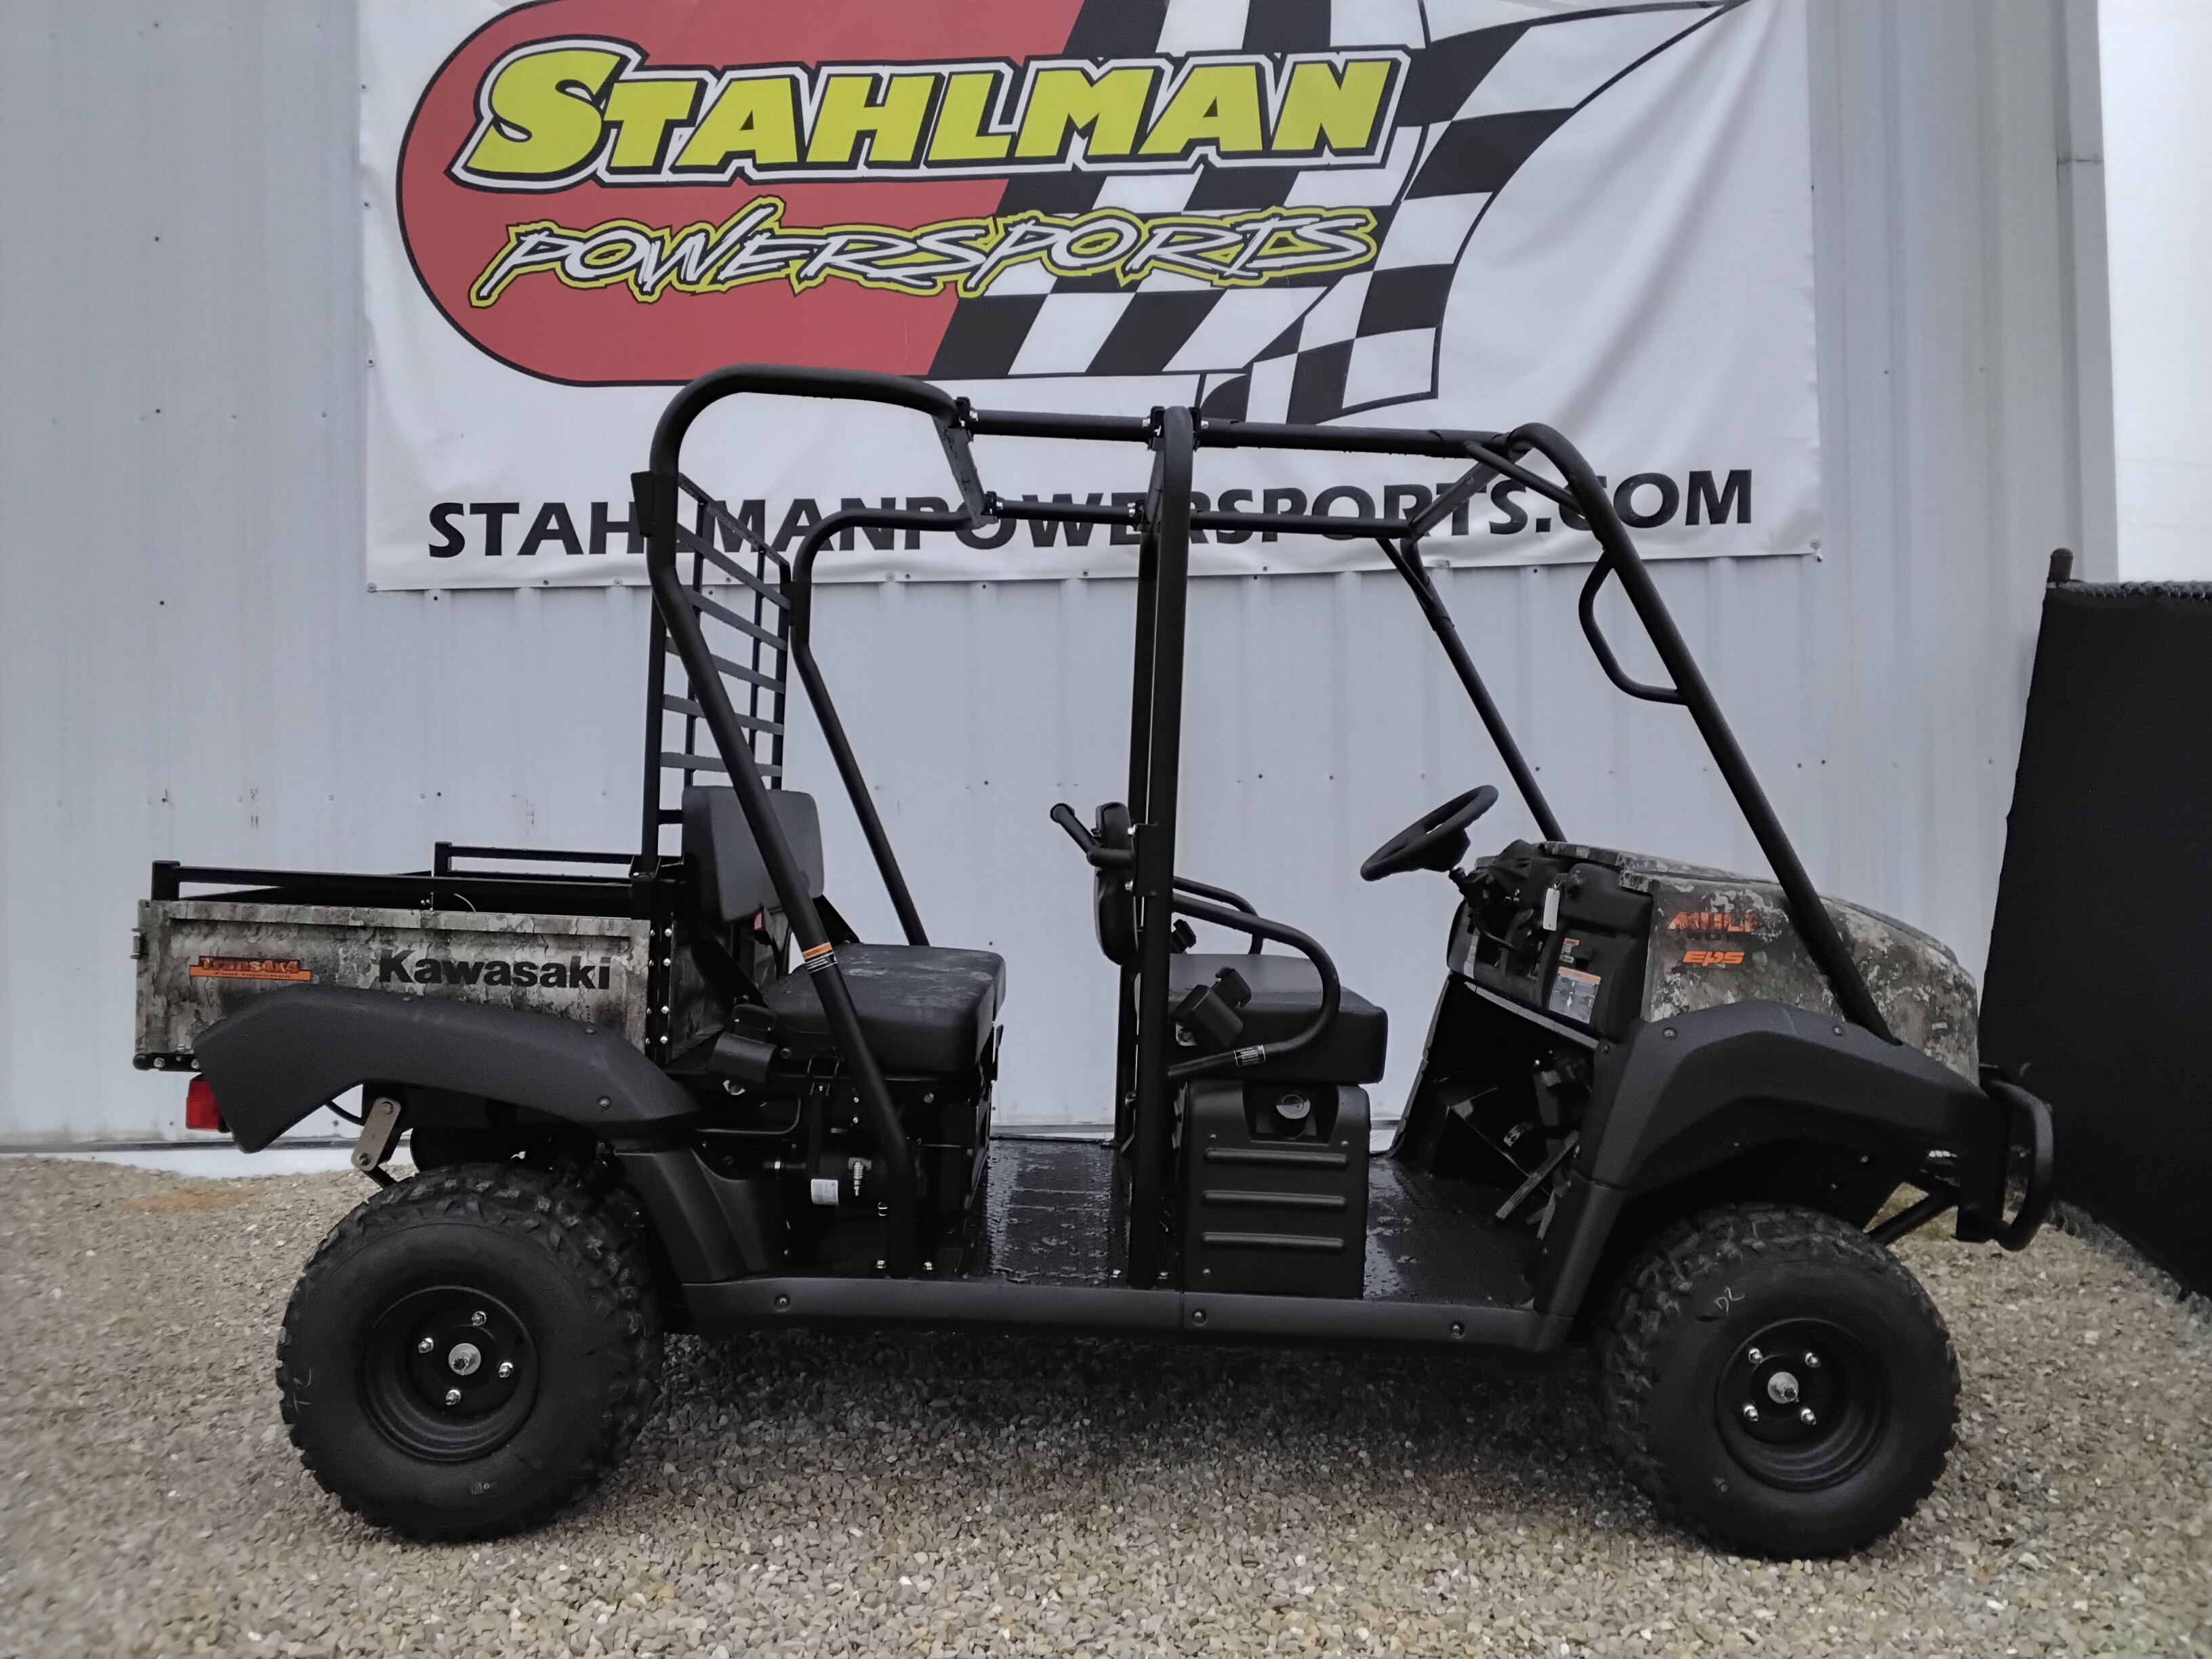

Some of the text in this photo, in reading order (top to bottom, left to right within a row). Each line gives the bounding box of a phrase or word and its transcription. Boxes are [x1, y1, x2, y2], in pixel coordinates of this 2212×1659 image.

[451, 39, 1404, 186] STAHLMAN
[474, 201, 1374, 304] POWERSPORTS
[429, 470, 1752, 557] STAHMANPOWESPORTS.OM
[380, 949, 610, 989] Kawasaki
